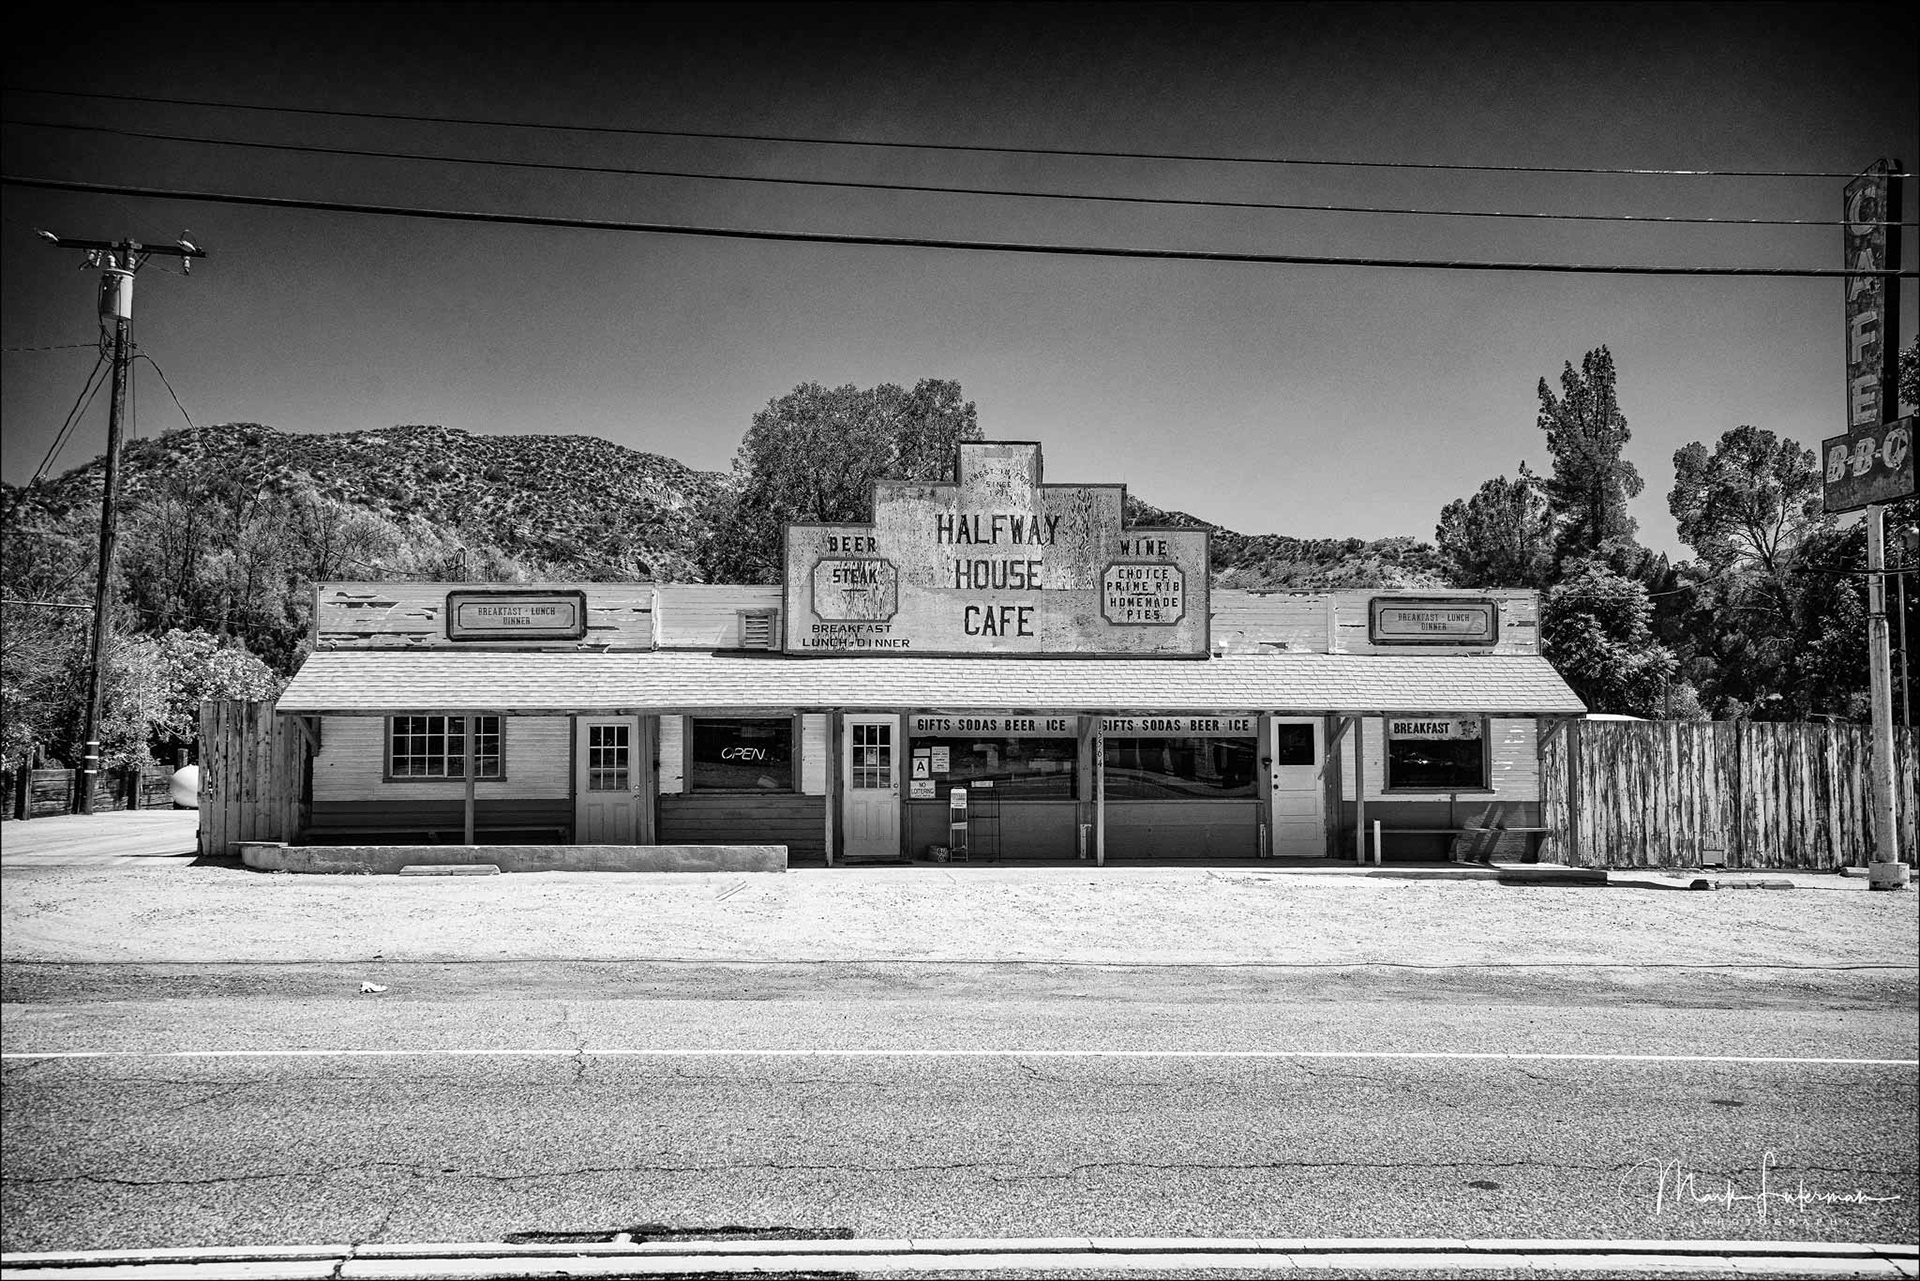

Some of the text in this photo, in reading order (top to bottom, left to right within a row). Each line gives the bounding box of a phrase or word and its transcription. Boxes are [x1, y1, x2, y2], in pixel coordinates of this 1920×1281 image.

[1847, 186, 1876, 426] CAFE
[1014, 472, 1035, 489] FOOD
[937, 514, 1061, 545] HALFWAY
[829, 536, 877, 552] BEER
[1120, 540, 1167, 556] WINE
[832, 568, 878, 584] STEAK
[955, 559, 1043, 590] HOUSE
[1118, 569, 1169, 579] CHOICE
[1106, 581, 1180, 592] PRIME RIB
[1110, 597, 1178, 608] HOMEMADE
[478, 607, 556, 616] BREAKFAST LUNCH
[1127, 609, 1160, 620] PIES
[1398, 613, 1470, 622] BREAKFAST LUNCH
[503, 616, 531, 625] DINNER
[964, 605, 1034, 637] CAFE
[1421, 622, 1447, 631] DINNER
[811, 624, 892, 633] BREAKFAST
[917, 719, 1066, 731] GIFTS SODAS BEER ICE
[1102, 719, 1249, 731] GIFTS SODAS BEER ICE
[1393, 722, 1450, 734] BREAKFAST
[721, 747, 766, 760] OPEN
[916, 761, 925, 772] A
